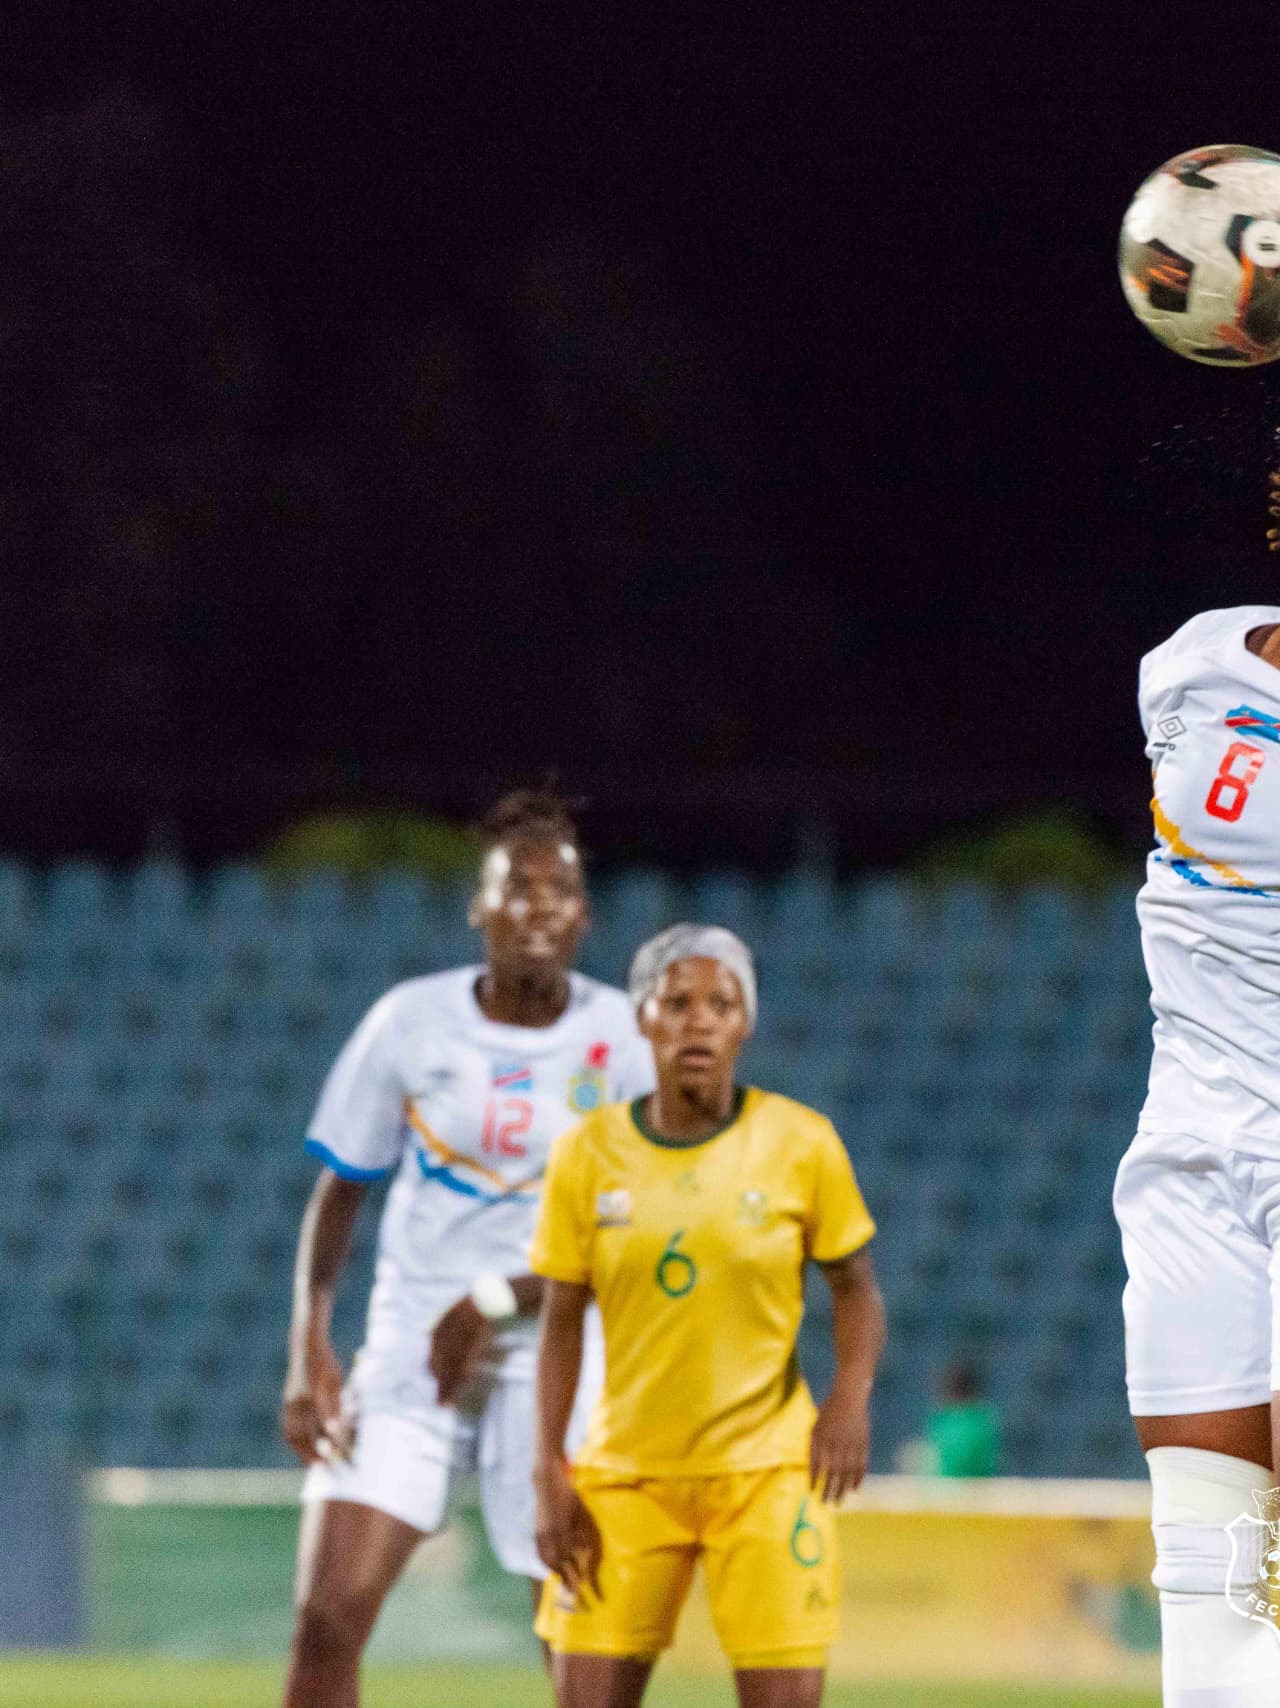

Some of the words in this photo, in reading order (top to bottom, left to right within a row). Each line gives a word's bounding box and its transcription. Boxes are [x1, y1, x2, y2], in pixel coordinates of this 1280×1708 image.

[1205, 742, 1264, 823] 8
[481, 1098, 532, 1157] 12
[656, 1226, 697, 1299] 6
[790, 1497, 824, 1568] 6
